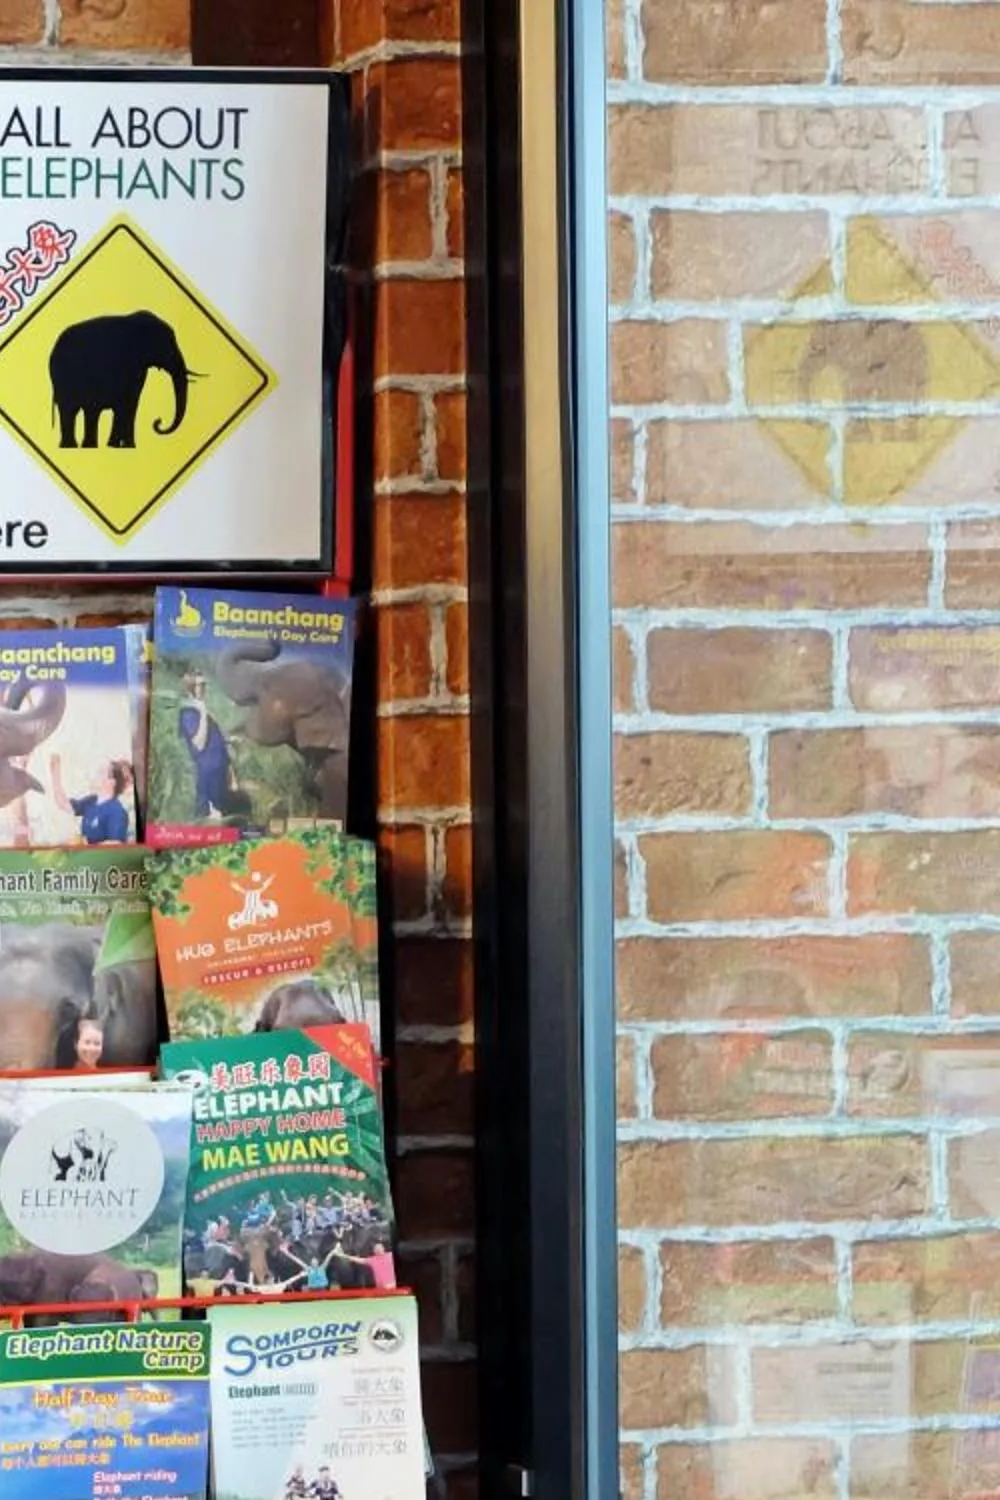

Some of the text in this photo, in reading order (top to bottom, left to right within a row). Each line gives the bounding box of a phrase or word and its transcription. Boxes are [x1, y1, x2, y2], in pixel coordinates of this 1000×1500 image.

[0, 105, 248, 150] ALL ABOUT
[0, 156, 245, 201] ELEPHANTS
[212, 602, 345, 631] Baanchang
[25, 663, 66, 681] Care
[43, 867, 99, 893] Family
[107, 866, 149, 890] Care
[224, 919, 333, 953] ELEPHANTS
[195, 1082, 344, 1120] ELEPHANT
[197, 1108, 346, 1143] HAPPY HOME
[203, 1133, 349, 1172] MAE WANG
[20, 1188, 140, 1208] ELEPHANT
[7, 1331, 202, 1358] Elephant Nature
[224, 1321, 362, 1377] SOMPORN
[145, 1353, 203, 1372] Camp
